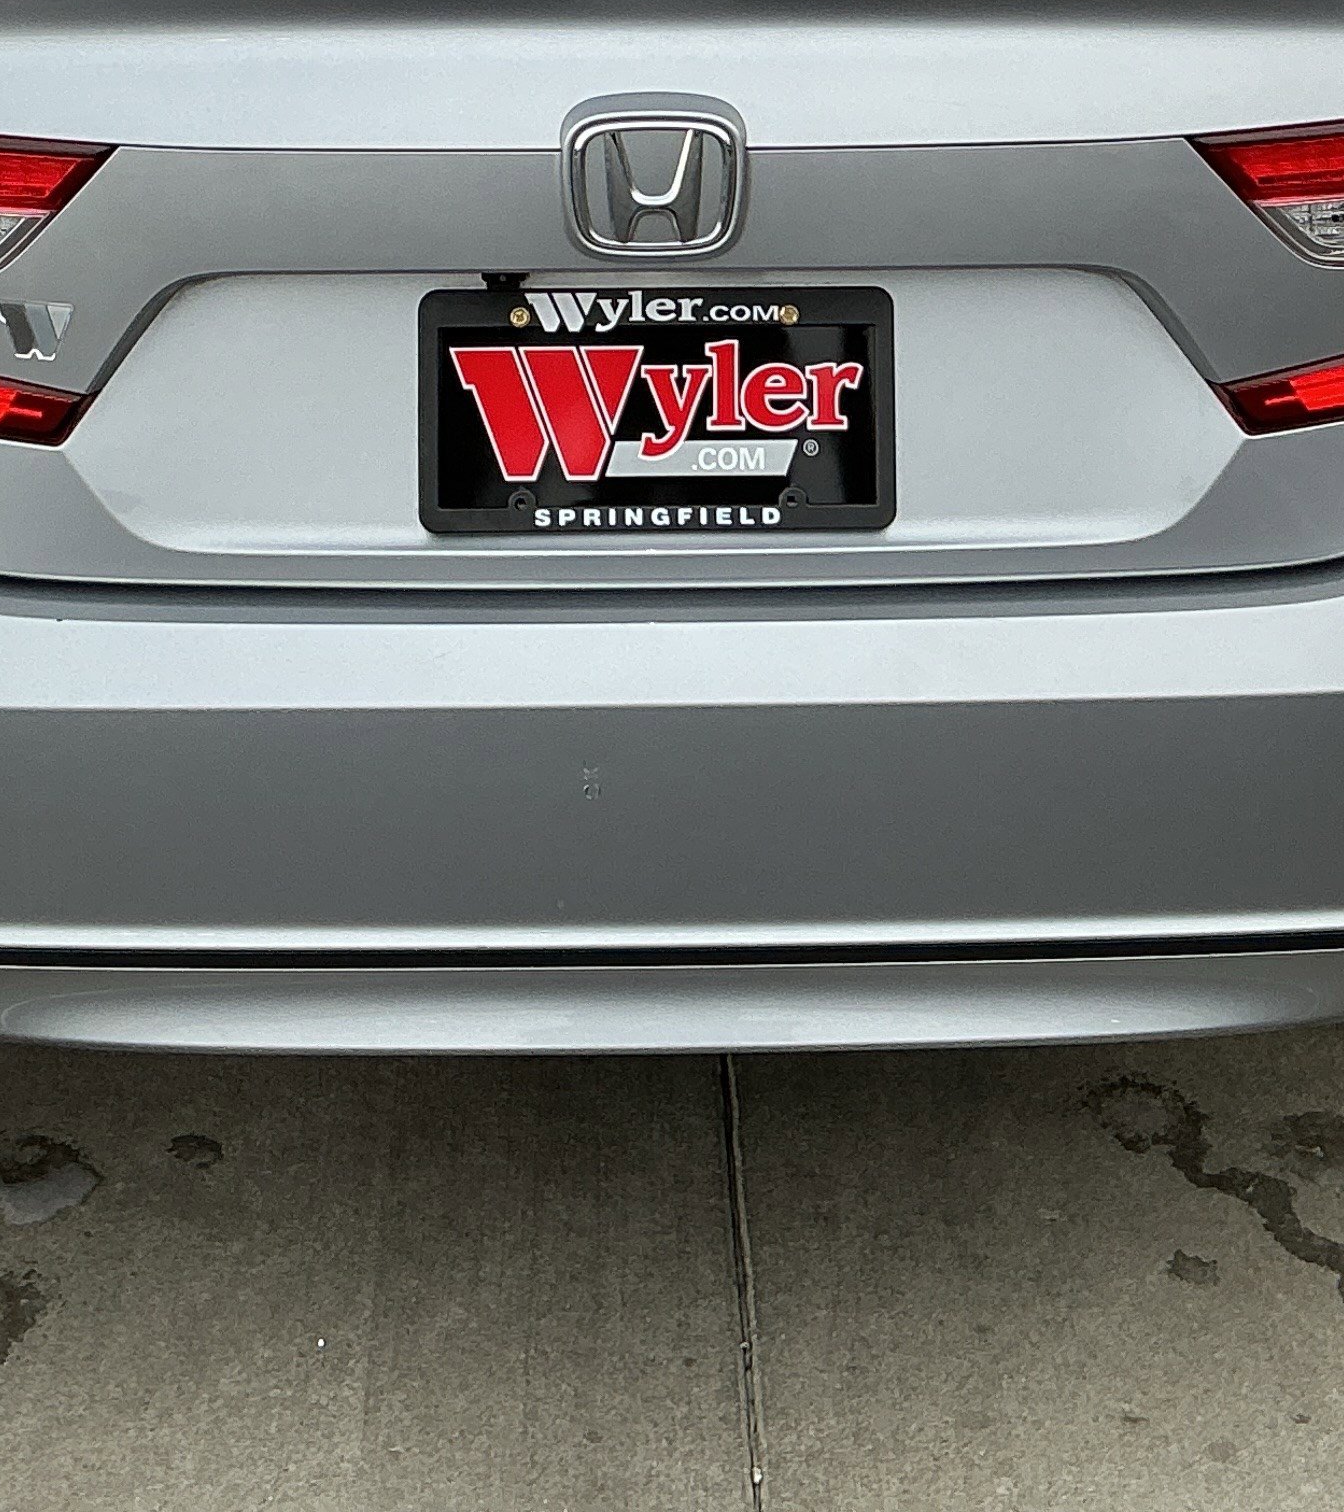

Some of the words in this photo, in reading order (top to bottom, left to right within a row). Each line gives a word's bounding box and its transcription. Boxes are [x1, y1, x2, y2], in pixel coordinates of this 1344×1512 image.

[449, 339, 863, 483] Wyler
[691, 446, 766, 472] .COM
[534, 506, 782, 528] SPRINGFIELD
